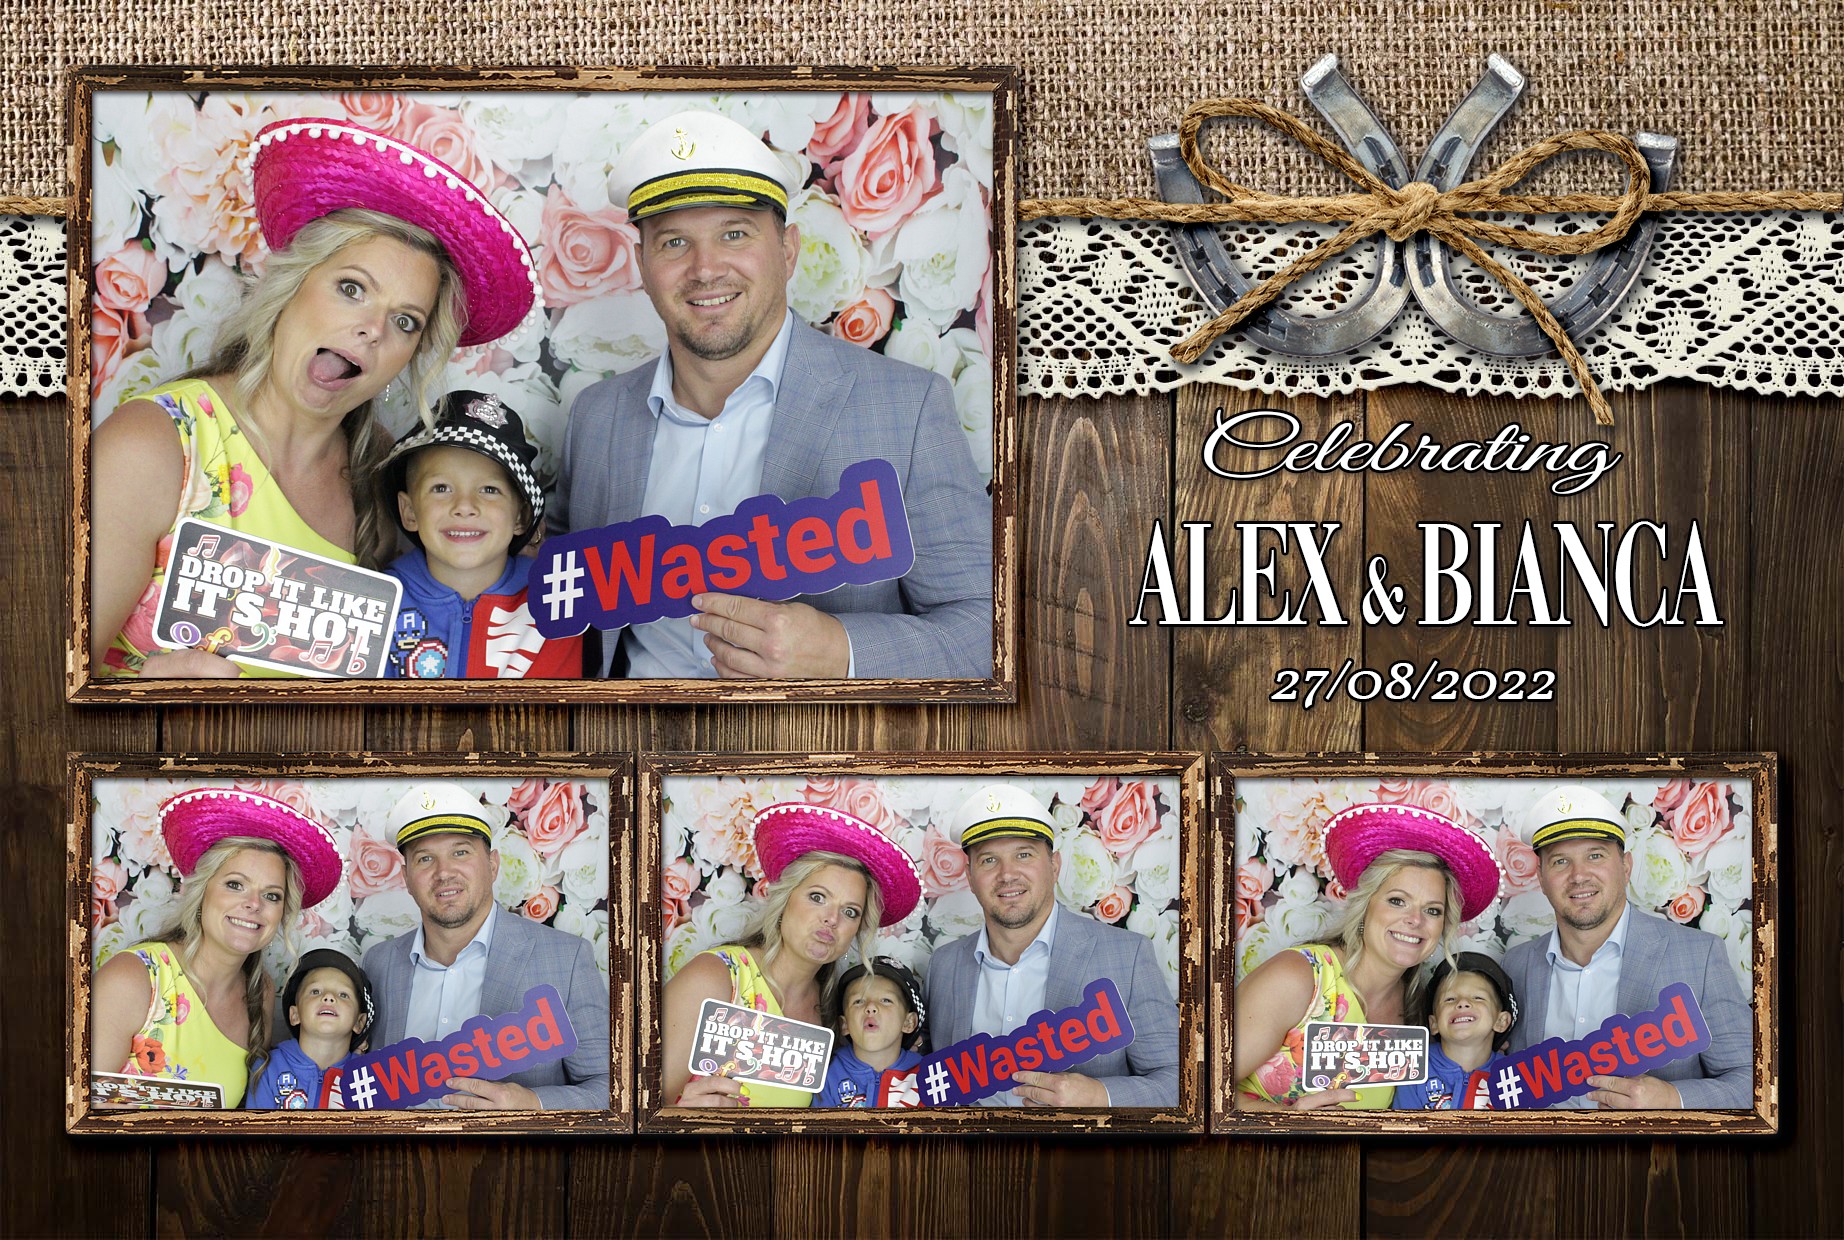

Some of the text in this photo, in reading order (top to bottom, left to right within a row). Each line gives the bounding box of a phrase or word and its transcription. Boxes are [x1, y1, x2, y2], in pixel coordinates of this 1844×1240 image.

[542, 479, 893, 622] #Wasted
[179, 553, 389, 624] DROP IT LIKE
[276, 601, 383, 656] HOT
[349, 997, 565, 1109] #Wasted
[704, 1019, 826, 1056] DROP IT LIKE
[761, 1044, 823, 1074] HOT
[925, 990, 1122, 1105] #Wasted
[1311, 1039, 1423, 1052] DROP IT LIKE
[1368, 1050, 1423, 1071] HOT
[1496, 995, 1699, 1109] #Wasted
